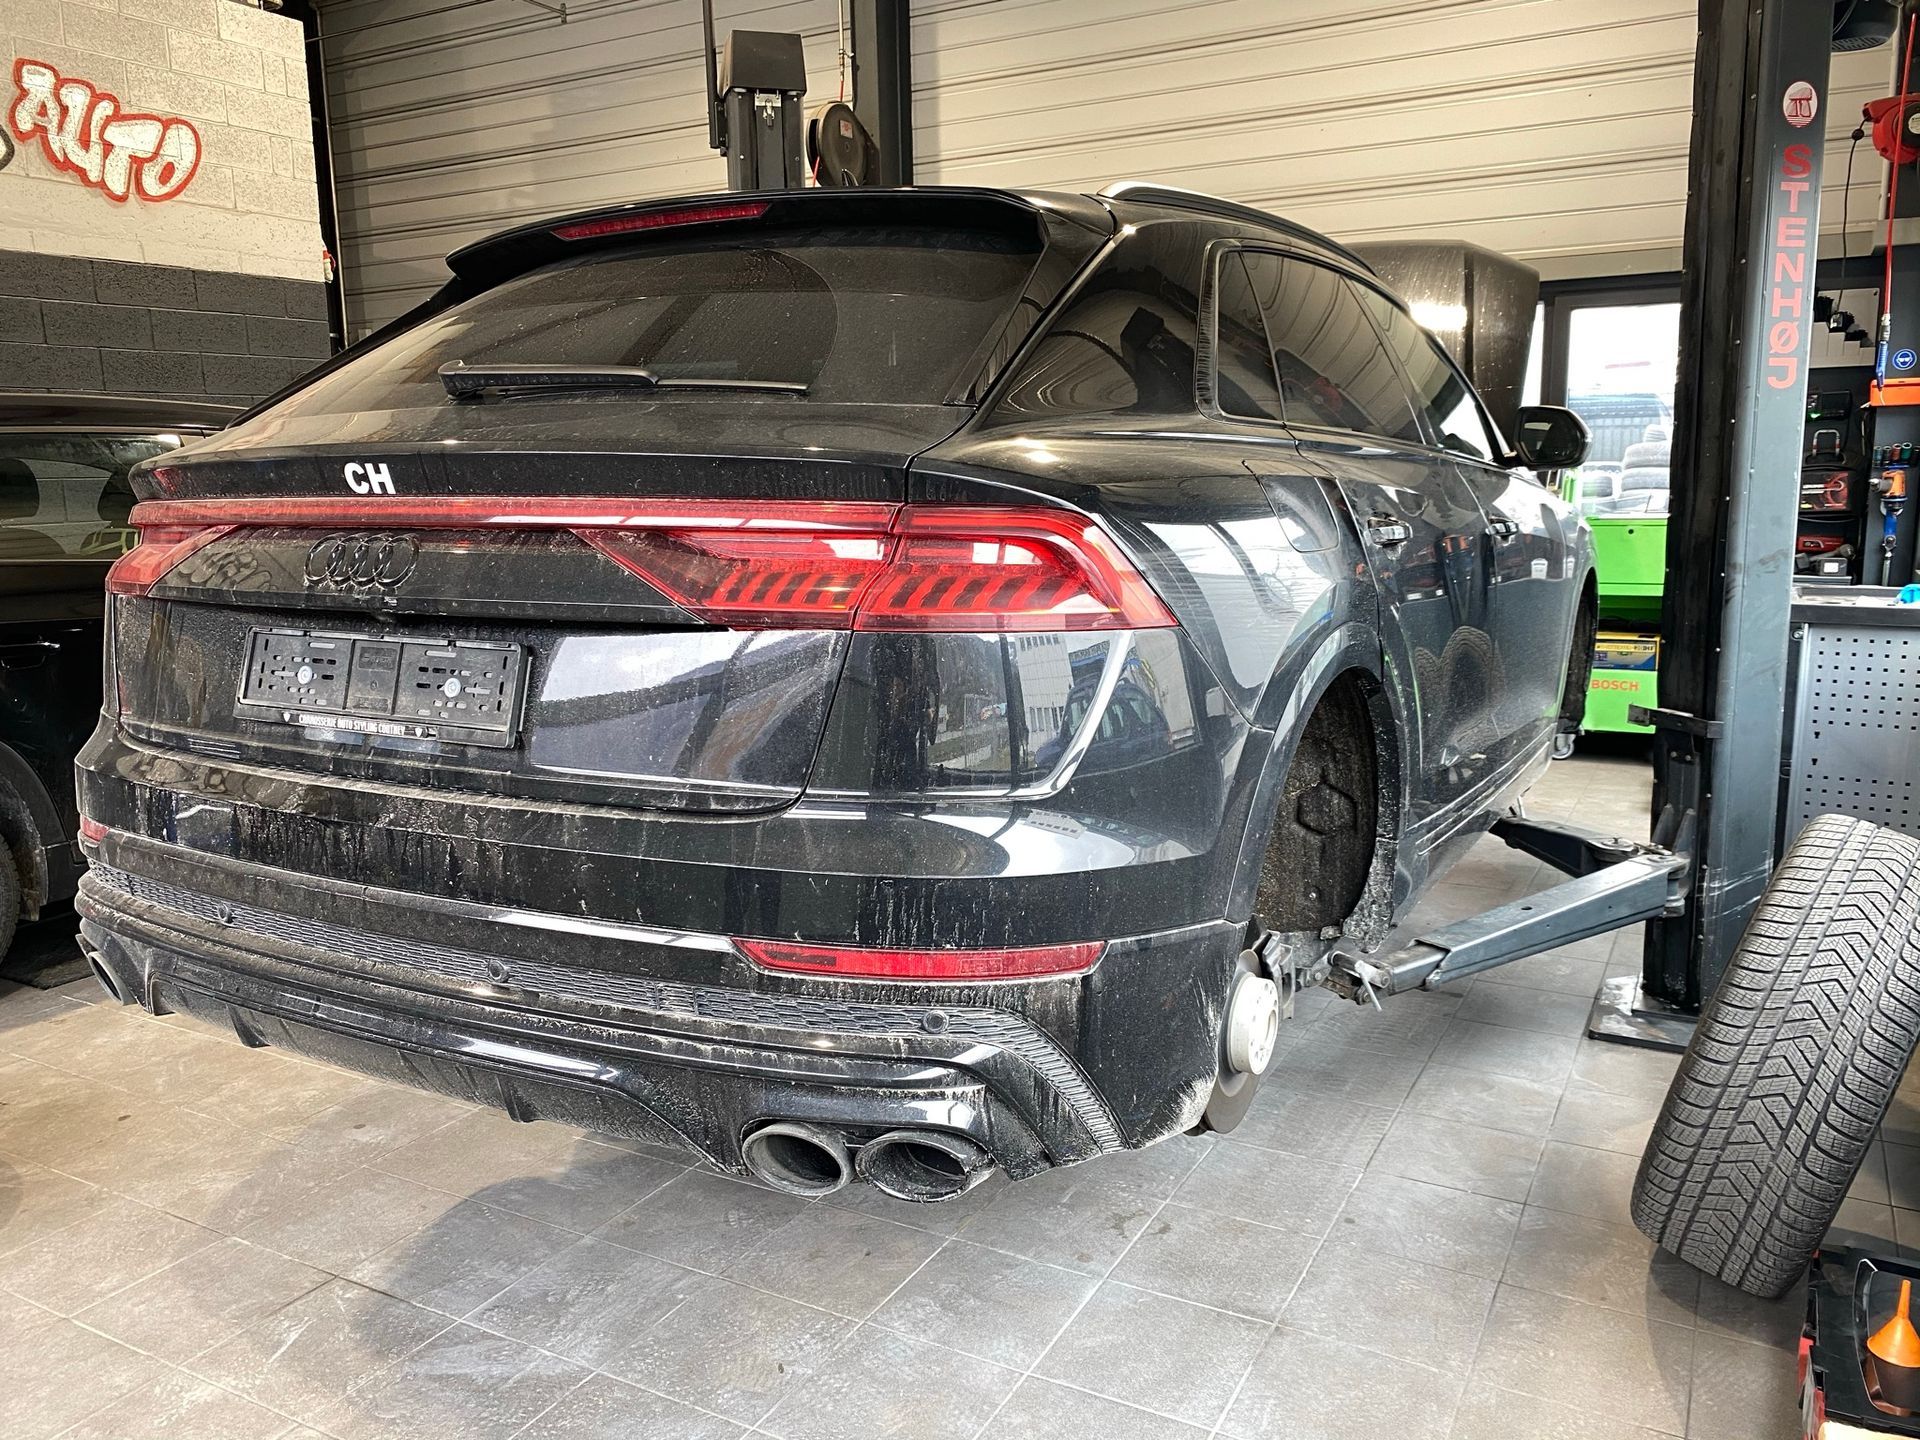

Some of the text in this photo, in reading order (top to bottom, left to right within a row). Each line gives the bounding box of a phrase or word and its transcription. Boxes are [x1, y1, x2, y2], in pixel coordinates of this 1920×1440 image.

[9, 57, 202, 203] AUTO
[1767, 144, 1812, 389] STENHØJ
[344, 462, 397, 495] CH
[1591, 679, 1639, 692] BOSCH
[337, 718, 353, 730] AUTO
[353, 720, 378, 733] STYLING
